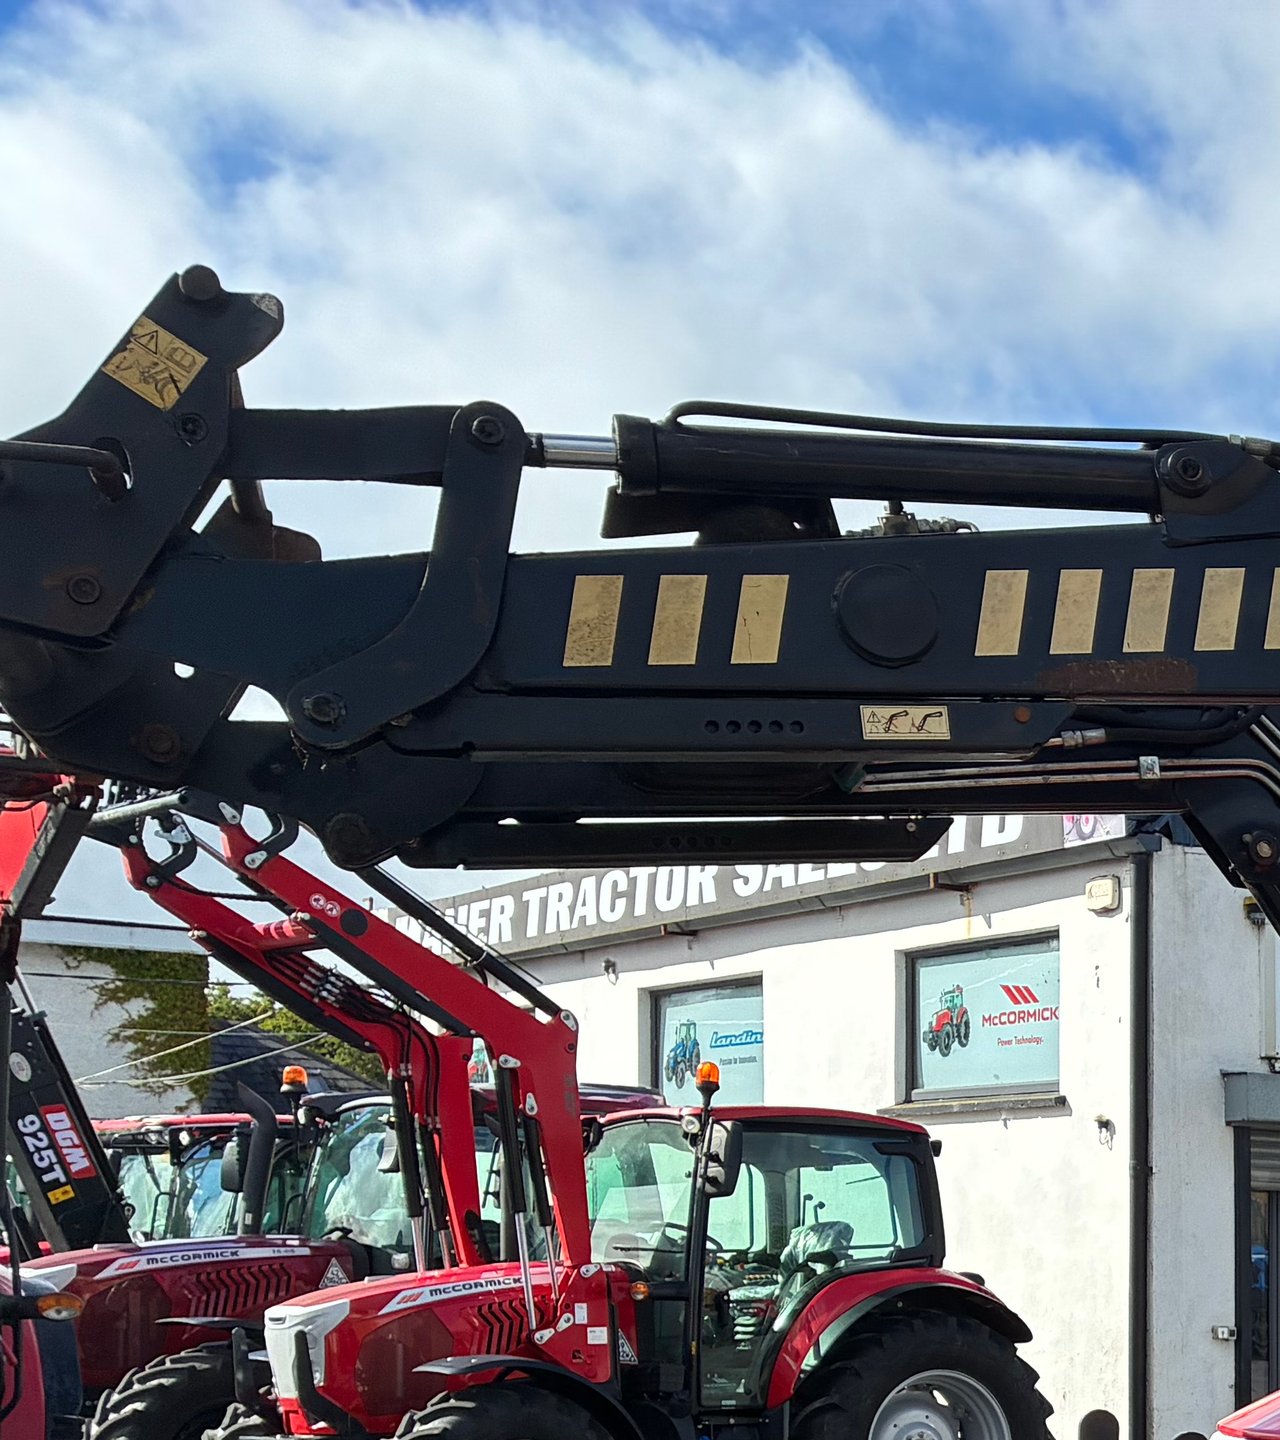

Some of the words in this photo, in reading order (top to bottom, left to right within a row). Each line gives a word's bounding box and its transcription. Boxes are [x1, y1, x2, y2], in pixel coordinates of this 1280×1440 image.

[523, 865, 719, 939] TRACTOR
[982, 1006, 1059, 1027] McCORMICK
[997, 1037, 1013, 1046] Power
[17, 1114, 67, 1184] 925T
[46, 1112, 90, 1173] DGM
